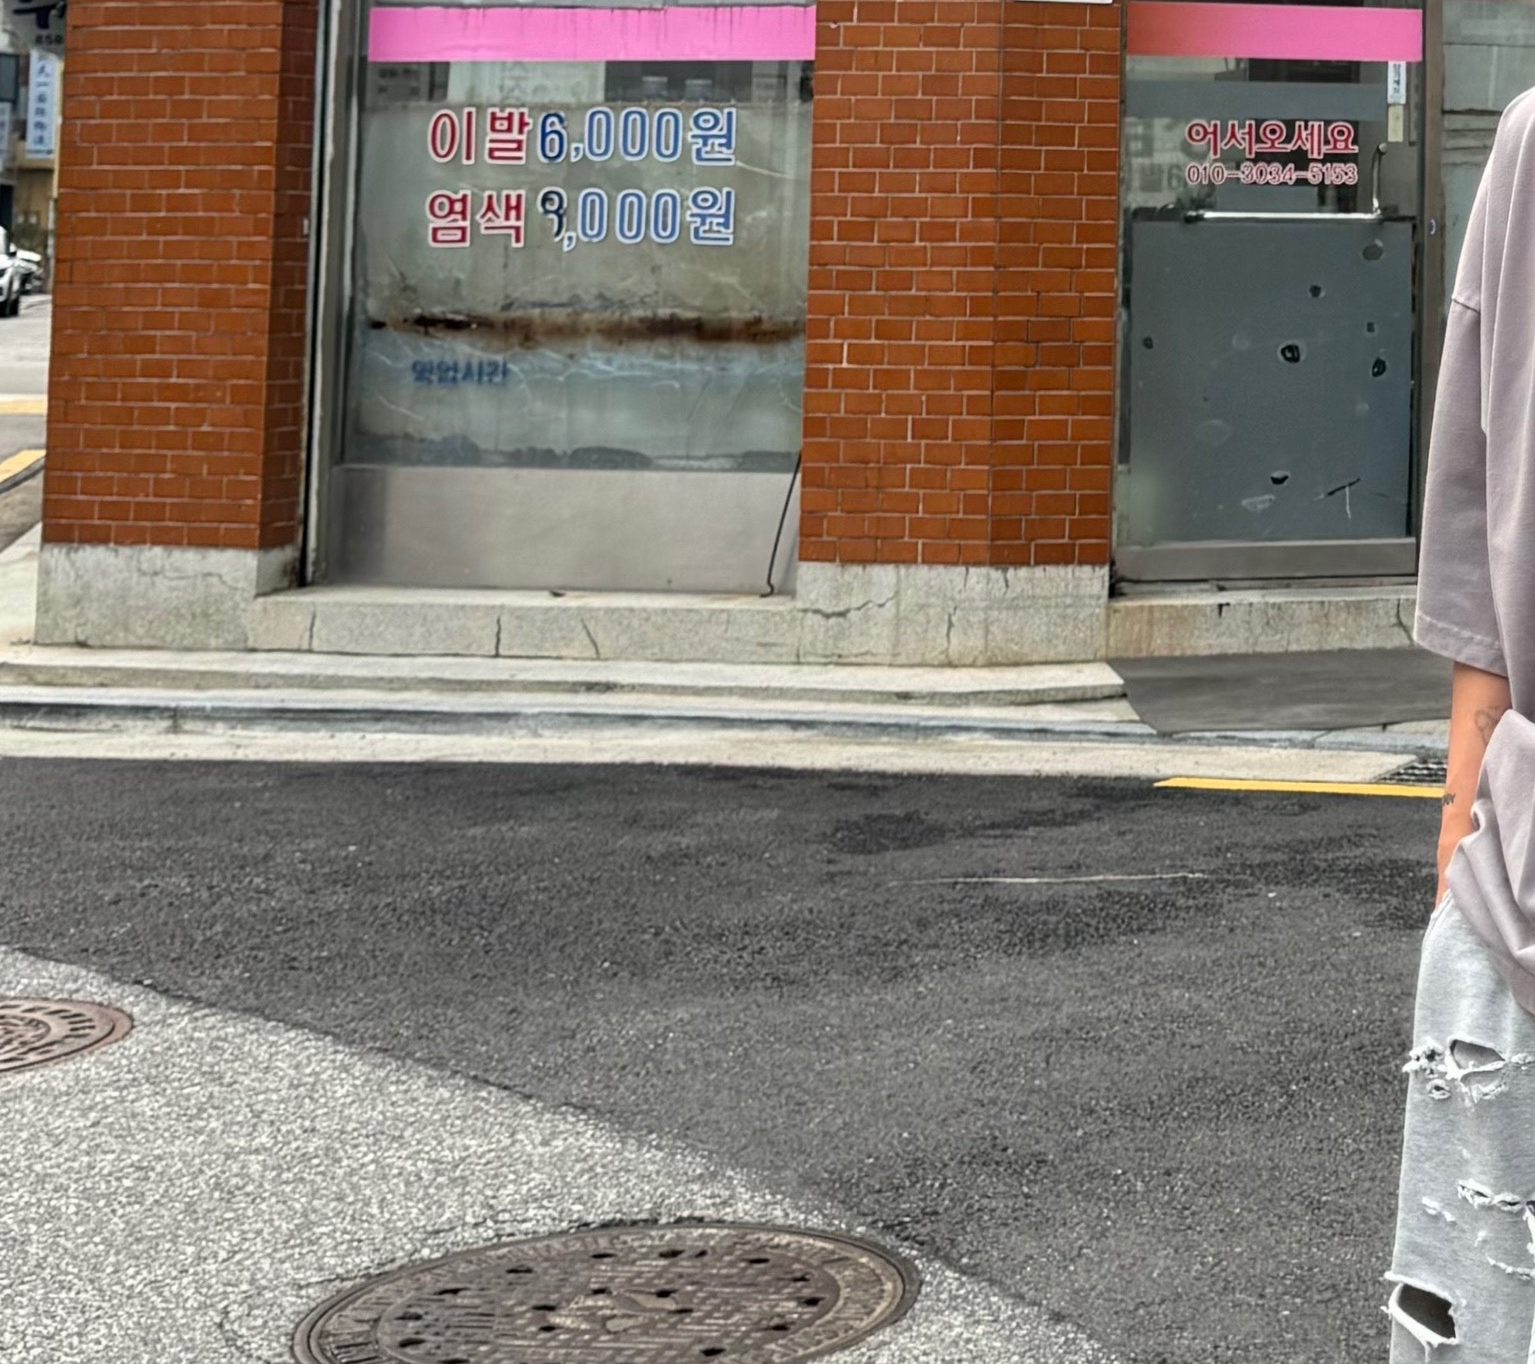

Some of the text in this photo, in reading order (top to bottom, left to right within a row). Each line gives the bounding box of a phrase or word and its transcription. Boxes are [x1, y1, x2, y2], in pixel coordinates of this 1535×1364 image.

[427, 106, 737, 166] 이발 6,000원
[1185, 119, 1359, 160] 어서오세요
[1185, 162, 1358, 185] 010-3034-5153
[426, 189, 526, 248] 염색
